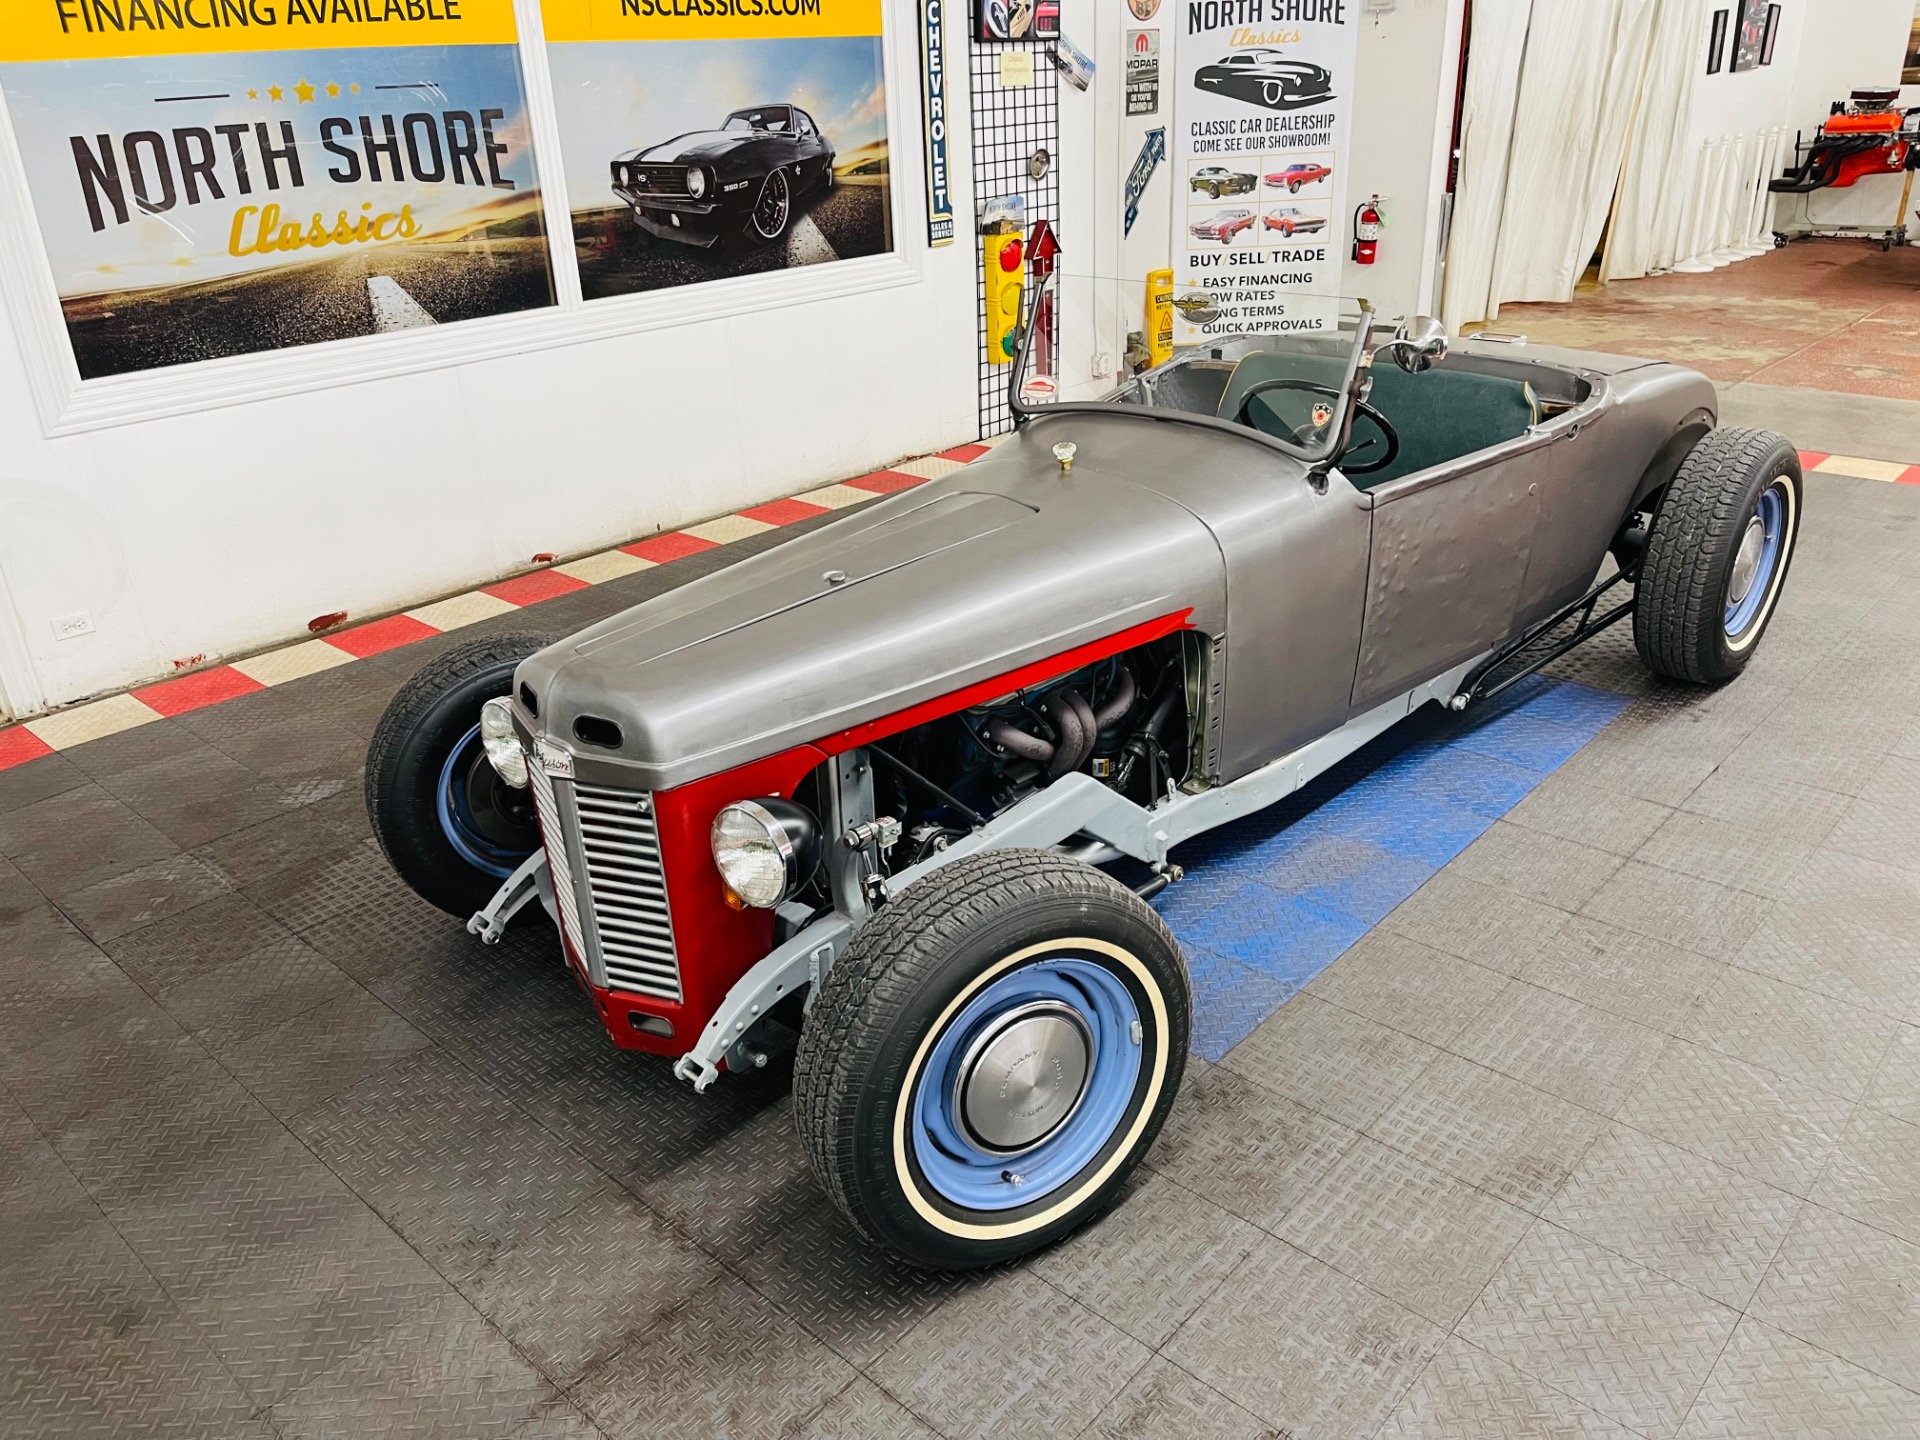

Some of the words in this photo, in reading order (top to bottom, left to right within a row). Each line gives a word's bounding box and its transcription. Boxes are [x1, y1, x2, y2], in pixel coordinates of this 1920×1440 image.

[56, 0, 277, 33] FINANCING
[287, 0, 462, 25] AVAILABLE
[621, 0, 821, 16] NSCLASSICS.COM
[1189, 0, 1262, 35] NORTH
[1271, 0, 1346, 25] SHORE
[1229, 27, 1302, 47] Classics
[927, 1, 946, 210] CHEVROLET
[1191, 120, 1236, 137] CLASSIC
[1240, 118, 1262, 134] CAR
[1266, 114, 1335, 132] DEALERSHIP
[1193, 138, 1221, 153] COME
[1225, 137, 1243, 151] SEE
[1246, 136, 1266, 150] OUR
[1268, 132, 1331, 149] SHOWROOM!
[69, 121, 306, 232] NORTH
[320, 109, 516, 190] SHORE
[229, 203, 422, 257] Classics
[931, 222, 948, 231] SALES
[1203, 277, 1236, 288] EASY
[1239, 273, 1313, 286] FINANCING
[1209, 292, 1232, 302] OW
[1236, 290, 1275, 302] RATES
[1242, 305, 1285, 317] TERMS
[1202, 323, 1243, 334] QUICK
[1246, 319, 1323, 332] APPROVALS
